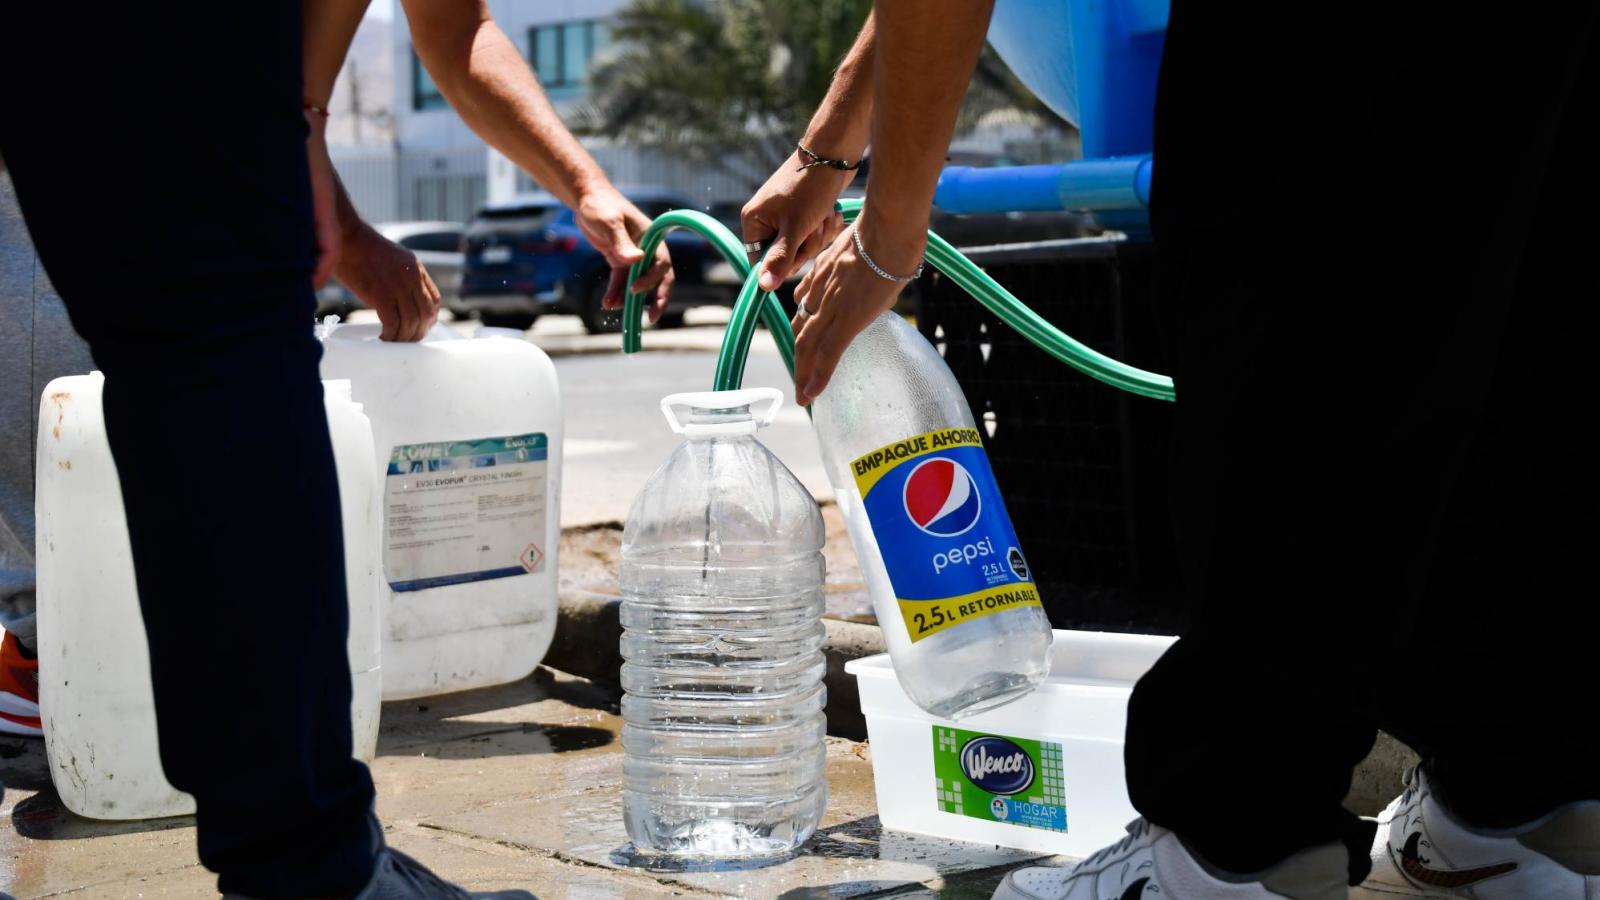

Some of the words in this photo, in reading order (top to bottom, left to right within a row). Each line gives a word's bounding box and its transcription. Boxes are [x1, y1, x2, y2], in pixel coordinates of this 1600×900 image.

[854, 437, 929, 477] EMPAQUE
[932, 430, 980, 448] AHORRO
[932, 535, 995, 575] pepsi
[998, 561, 1007, 573] L
[913, 605, 946, 635] 2.5
[946, 609, 957, 622] L
[958, 589, 1036, 617] RETORNABLE
[968, 746, 1023, 780] Wenco
[1014, 801, 1059, 819] HOGAR
